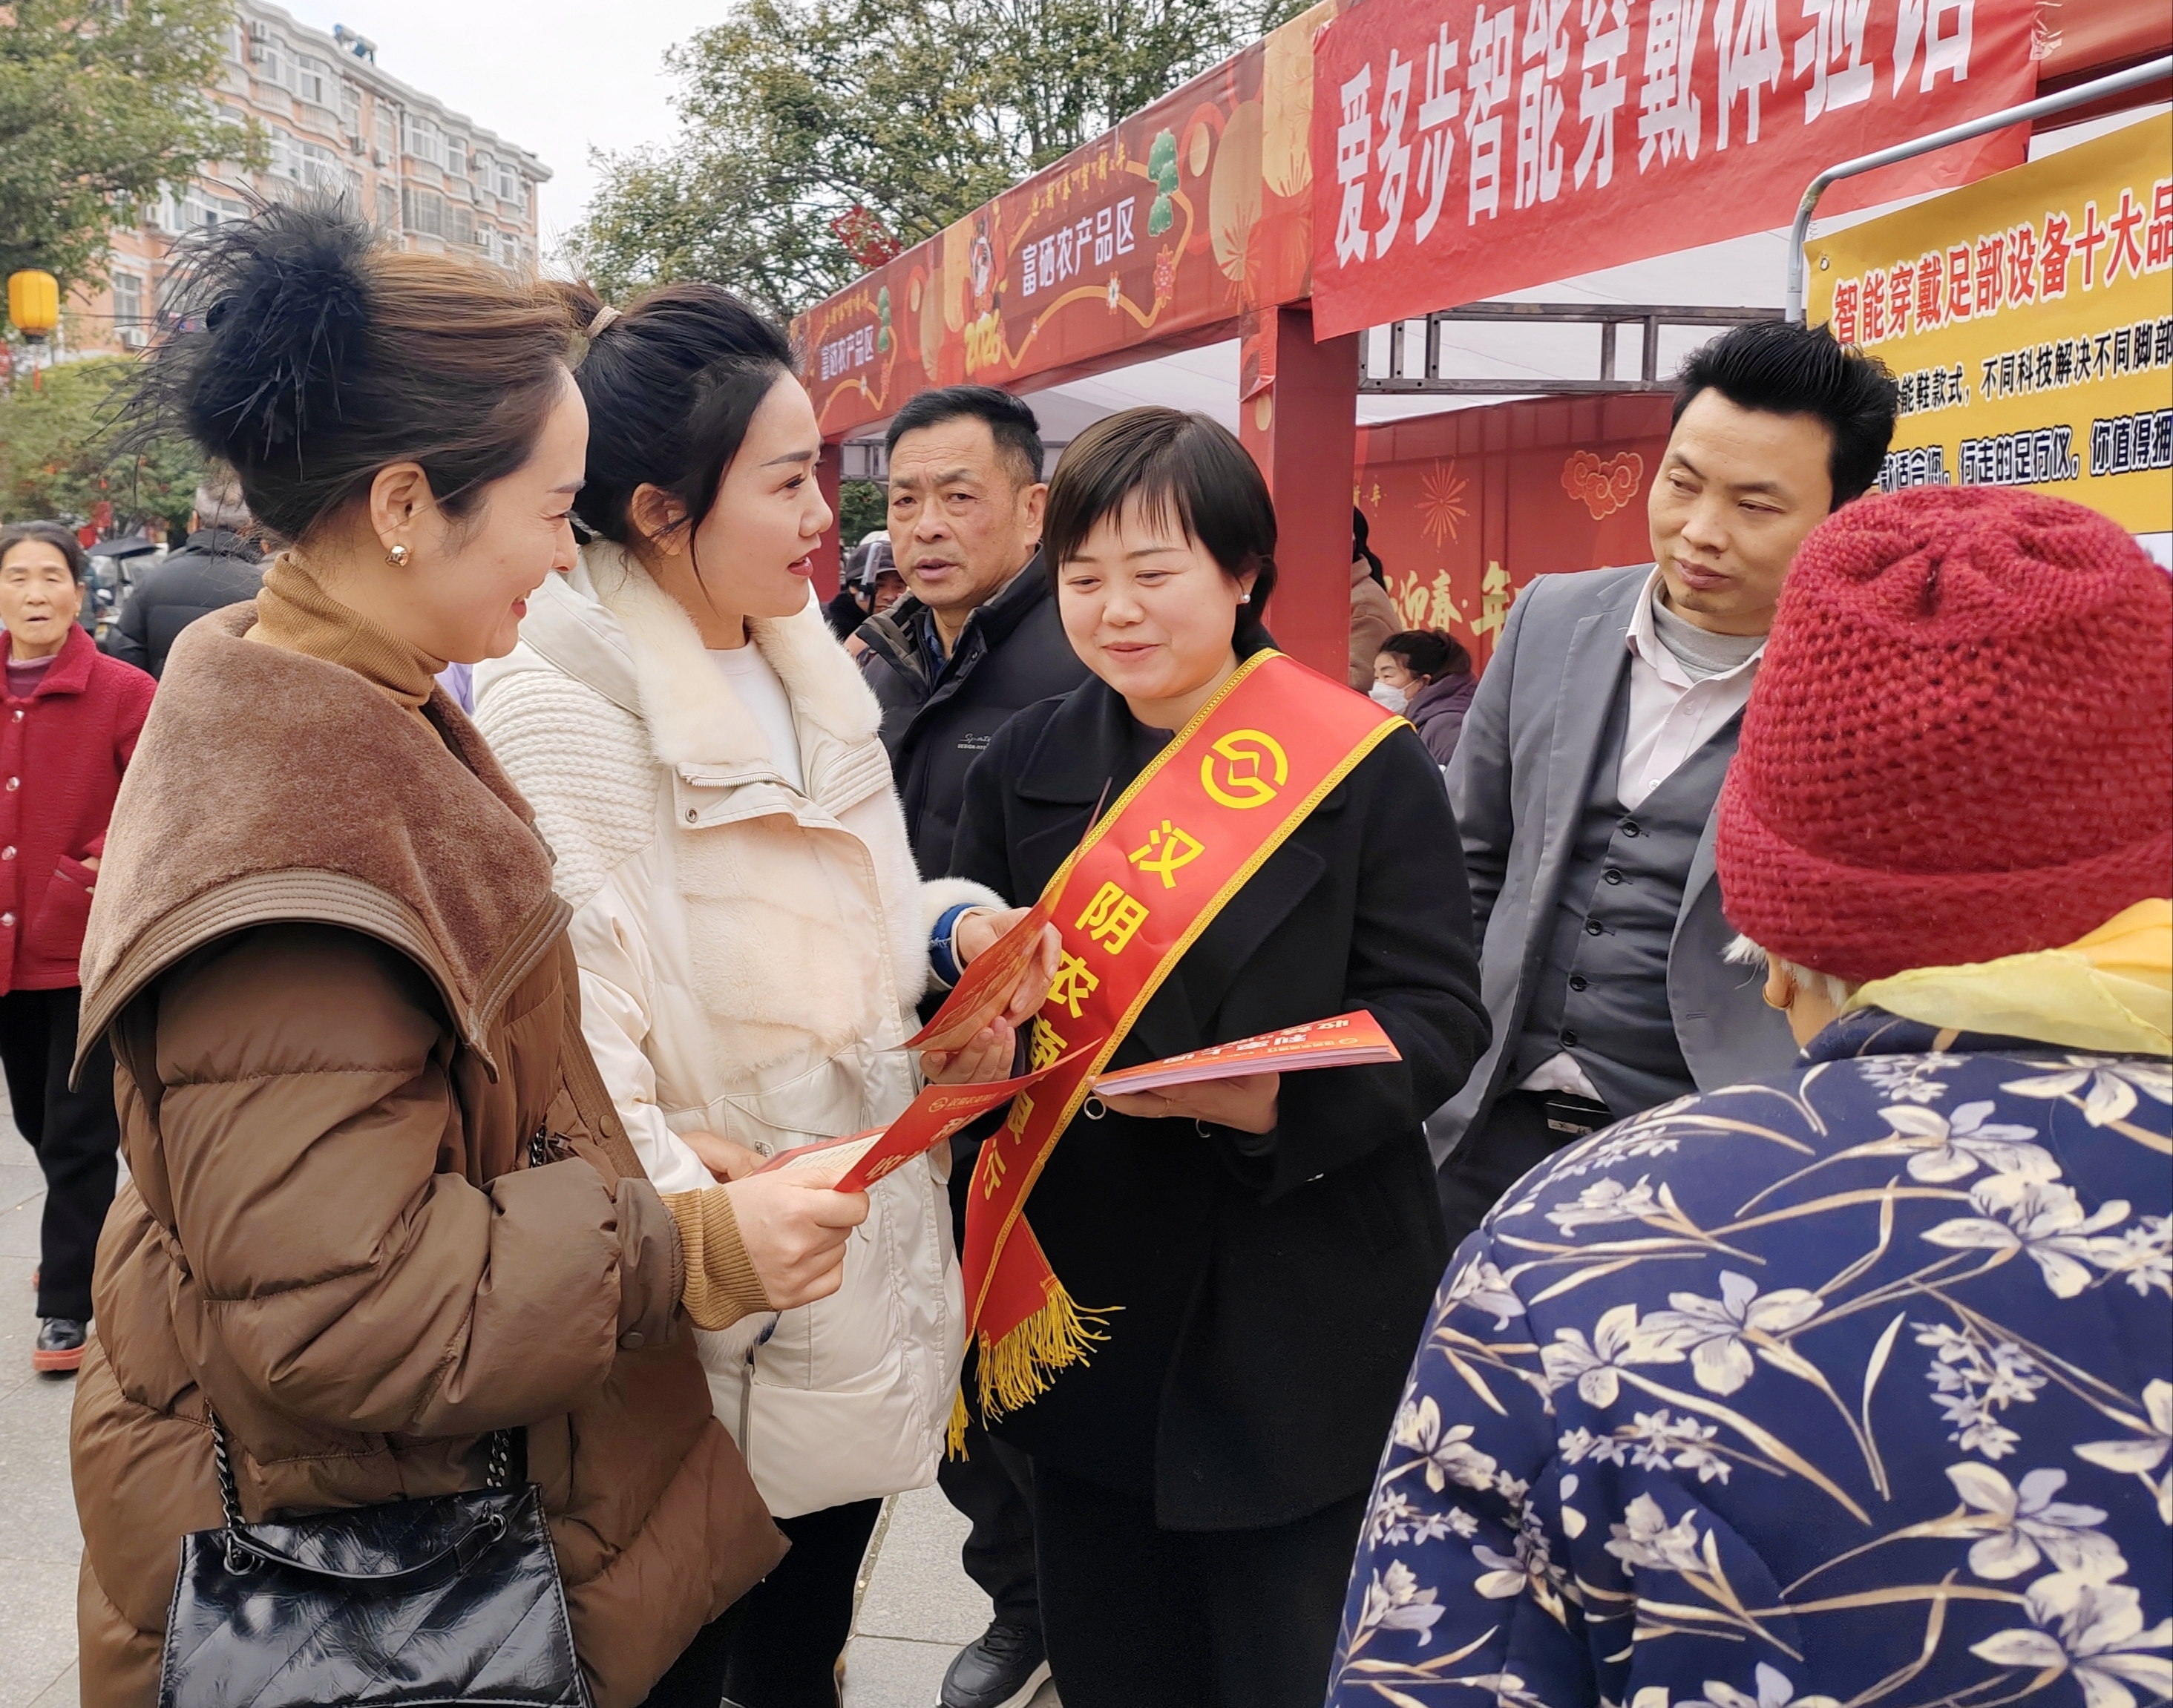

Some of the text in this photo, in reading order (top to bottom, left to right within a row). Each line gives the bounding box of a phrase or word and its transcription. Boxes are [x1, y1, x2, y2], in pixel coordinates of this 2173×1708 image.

[1022, 196, 1135, 297] 富硒农产品区
[1834, 184, 2173, 344] 智能穿戴足部设备十大品
[964, 309, 1002, 376] 2026
[1891, 319, 2173, 414] 能鞋款式，不同科技解决不同脚部
[1873, 410, 2173, 493] 款适合您，行走的足疗仪，你值得拥
[1384, 561, 1529, 645] 迎春·年
